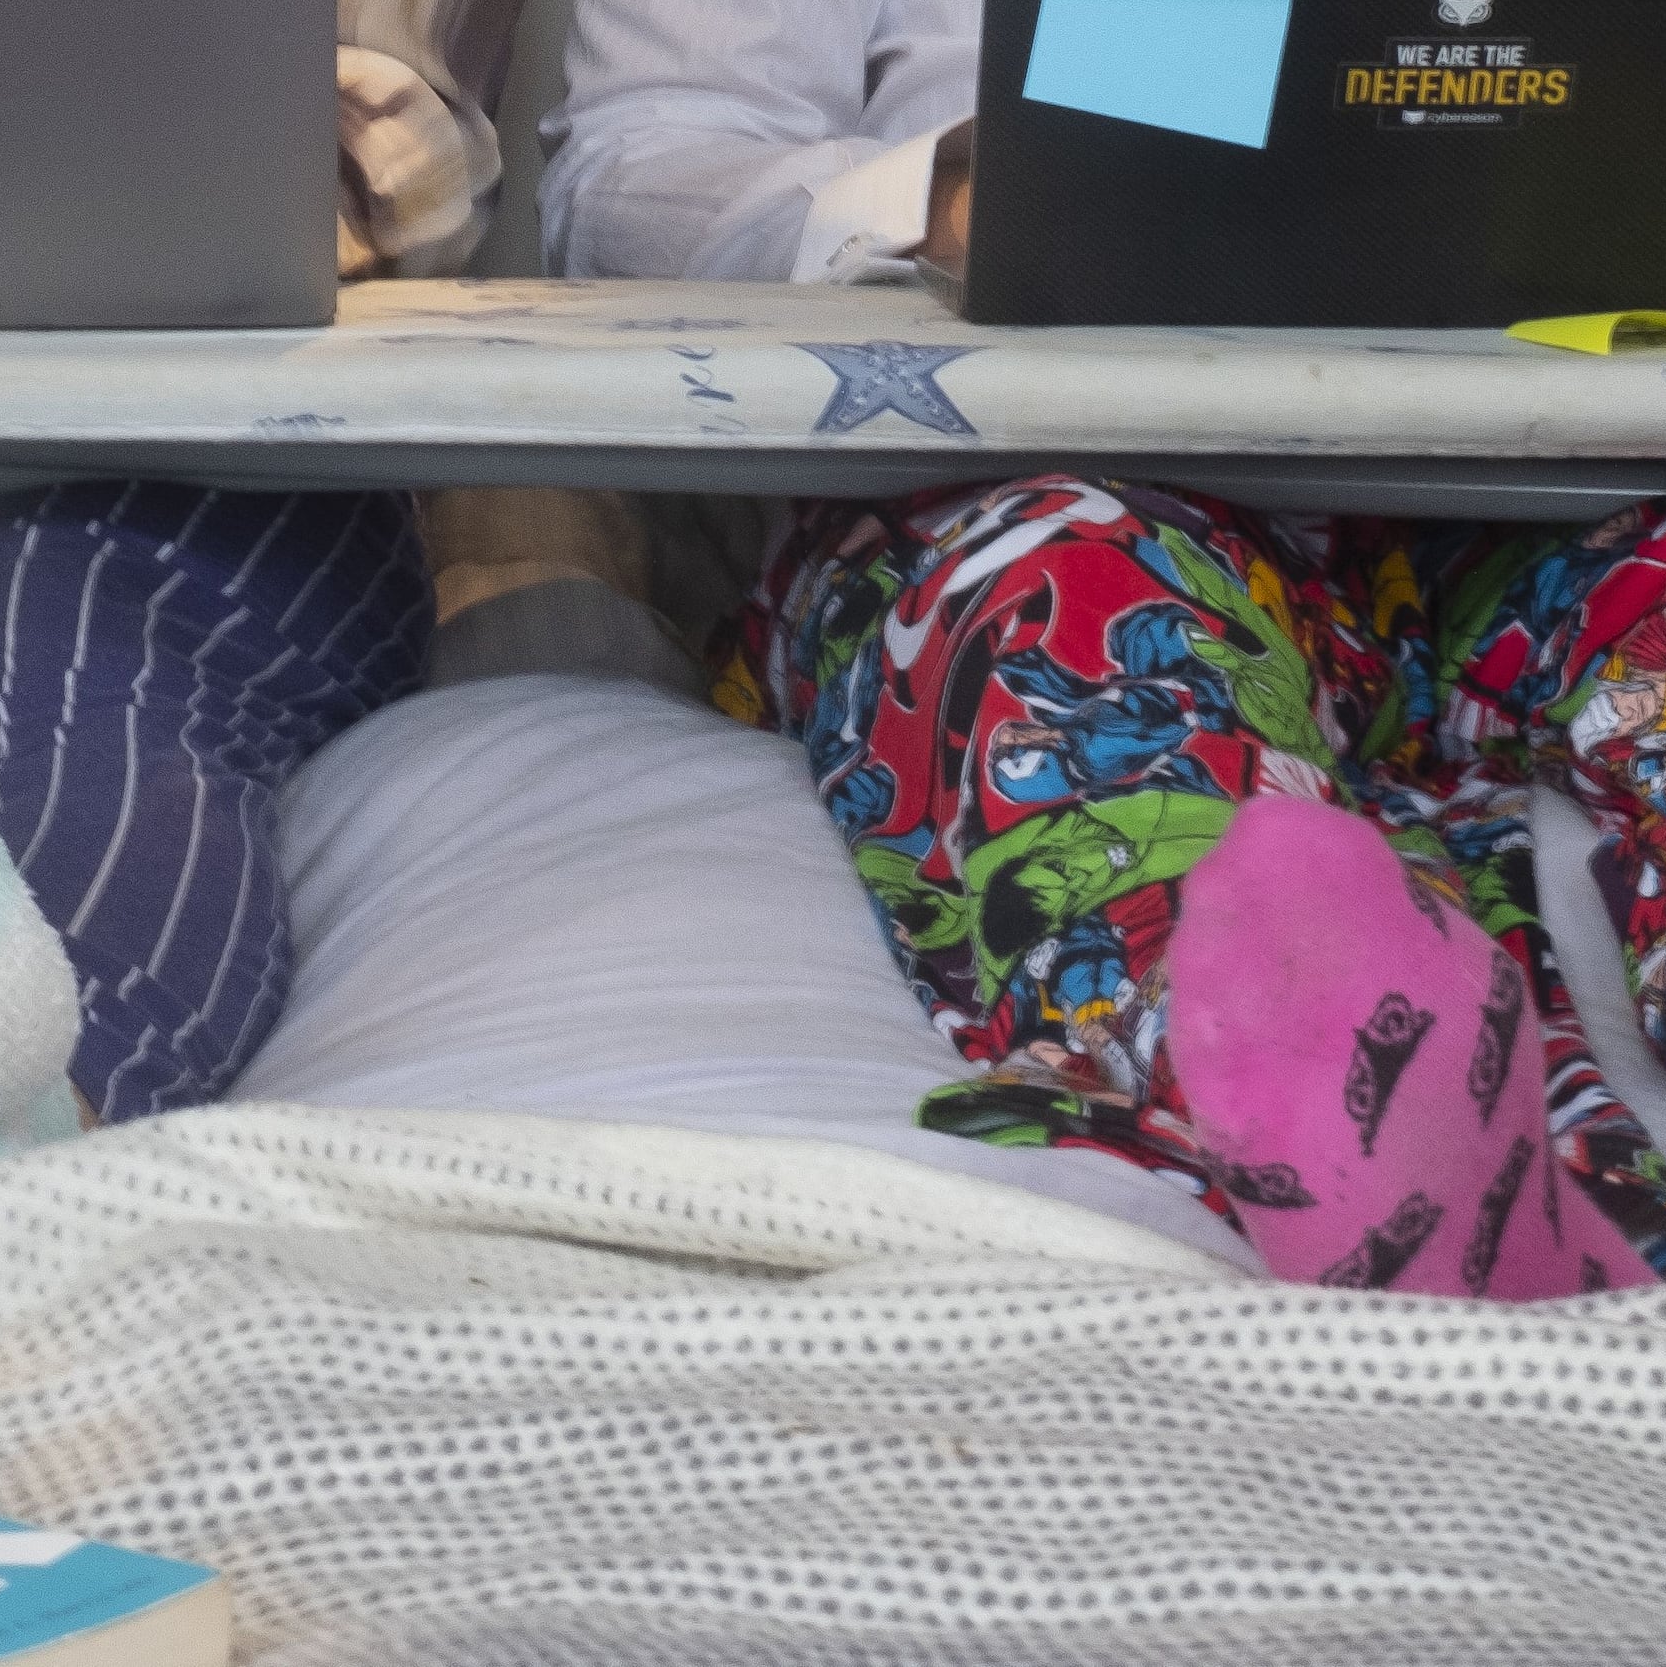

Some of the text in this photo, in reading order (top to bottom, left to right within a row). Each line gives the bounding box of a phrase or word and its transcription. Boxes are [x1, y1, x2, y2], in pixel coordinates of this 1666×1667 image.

[1396, 45, 1527, 67] WE ARE THE
[1344, 68, 1571, 106] DEFENDERS
